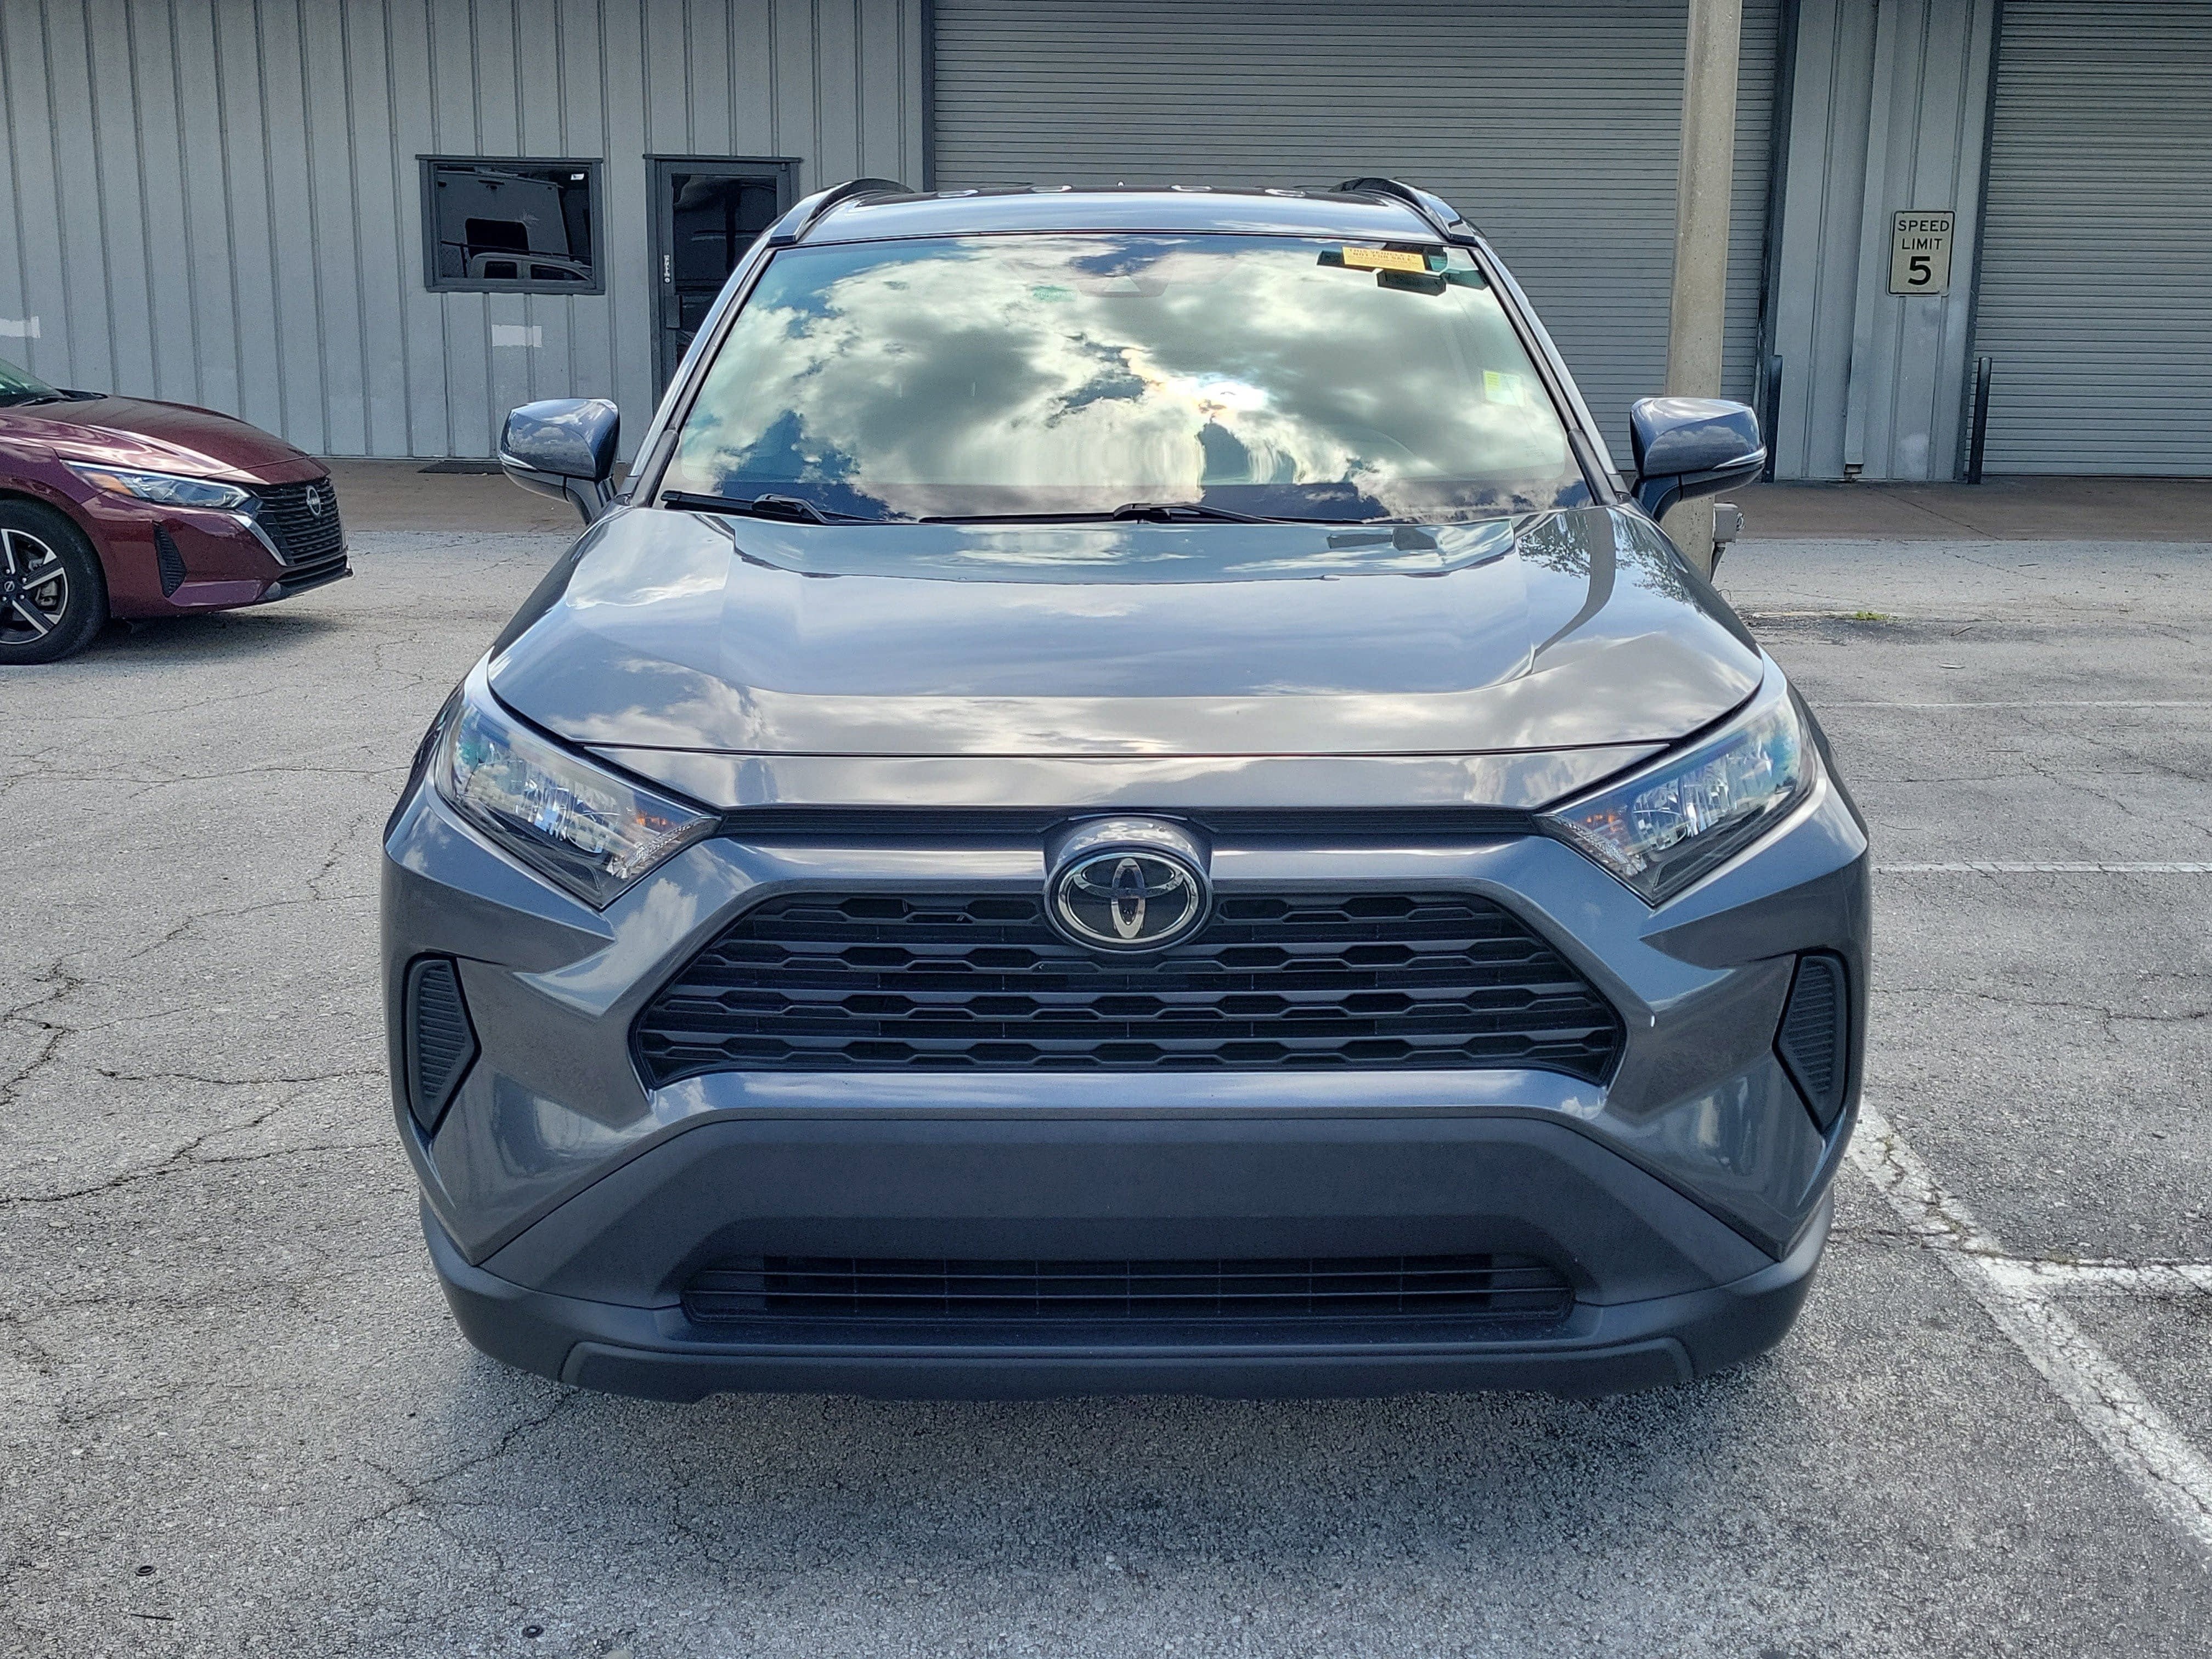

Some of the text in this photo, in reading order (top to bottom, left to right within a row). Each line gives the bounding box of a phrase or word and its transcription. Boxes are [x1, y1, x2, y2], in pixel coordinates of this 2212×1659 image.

[1898, 220, 1949, 232] SPEED
[1901, 238, 1943, 250] LIMIT
[1908, 256, 1931, 285] 5
